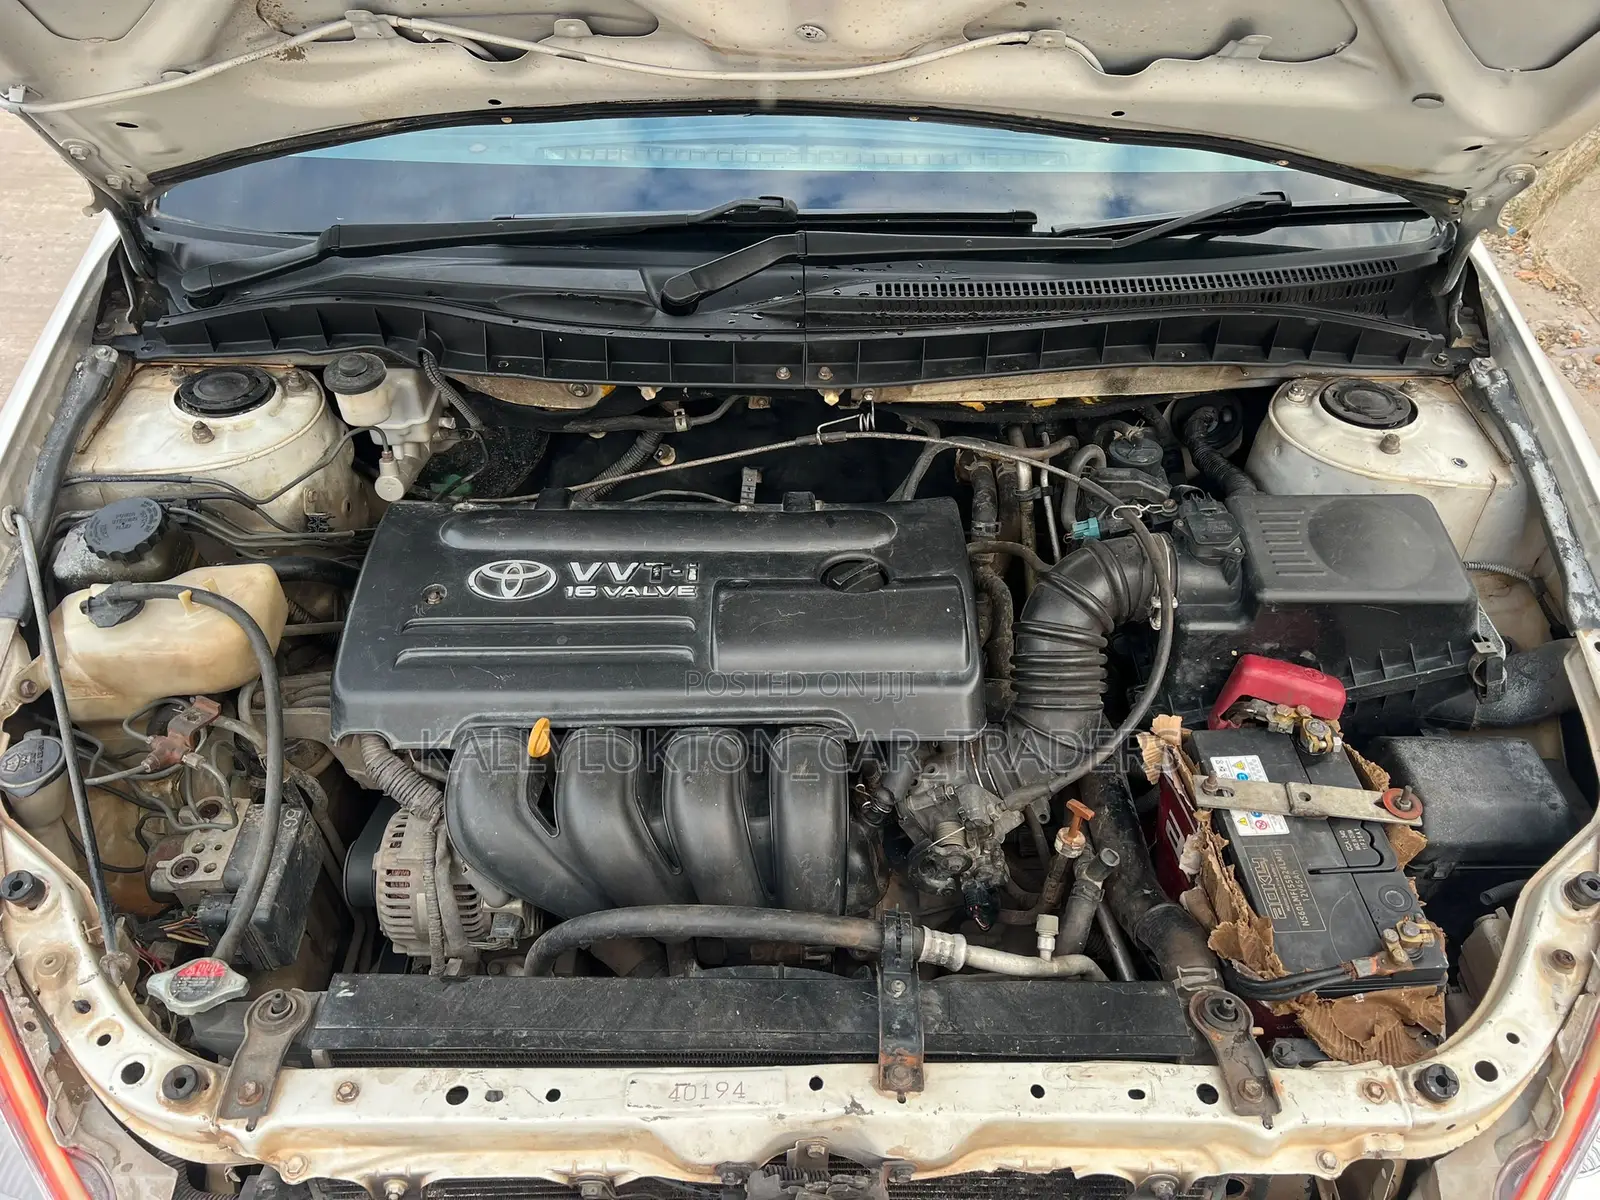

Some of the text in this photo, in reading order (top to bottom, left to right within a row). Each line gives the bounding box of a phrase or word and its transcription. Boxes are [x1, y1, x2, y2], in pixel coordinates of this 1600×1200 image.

[568, 562, 699, 582] VVT-i
[565, 585, 698, 598] 16 VALVE
[668, 1081, 745, 1102] 40194
